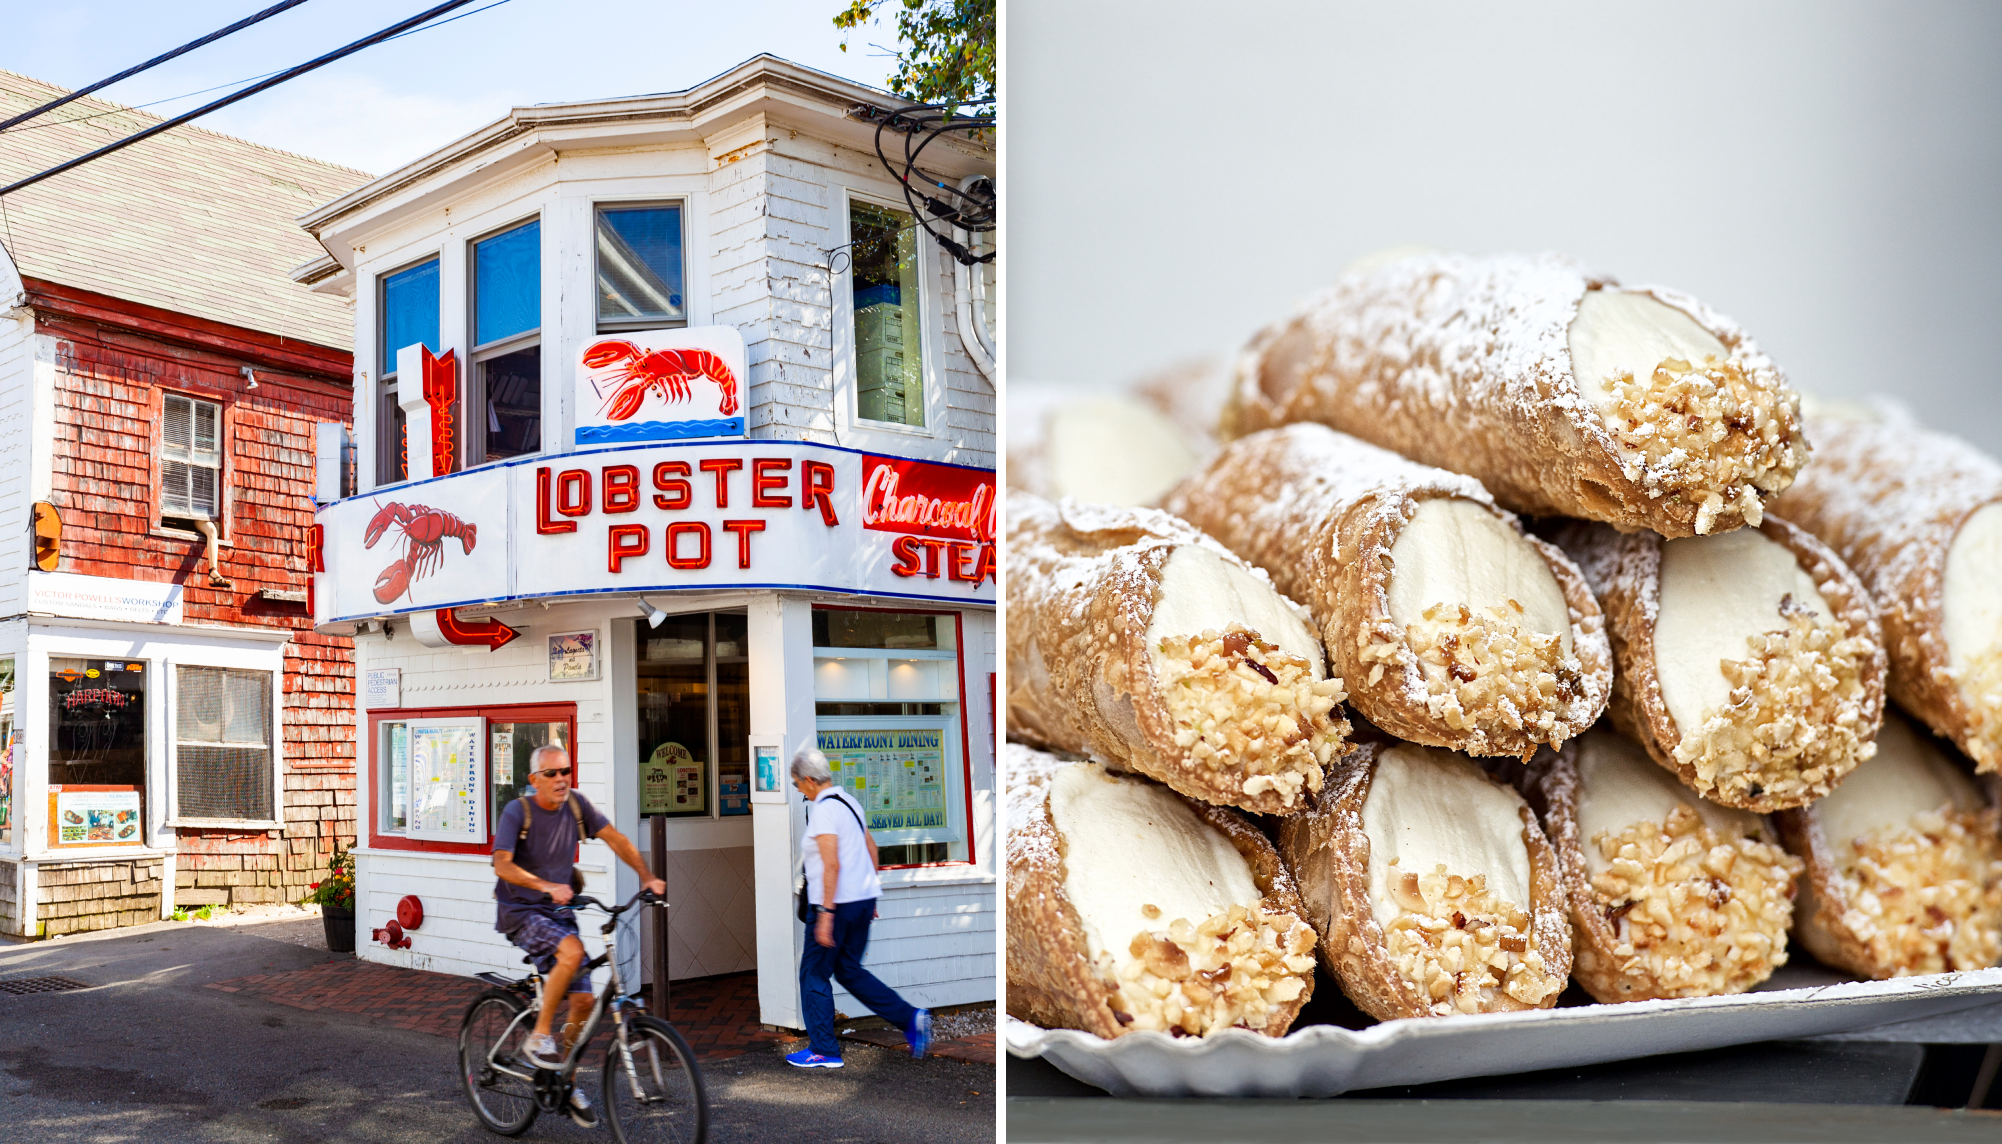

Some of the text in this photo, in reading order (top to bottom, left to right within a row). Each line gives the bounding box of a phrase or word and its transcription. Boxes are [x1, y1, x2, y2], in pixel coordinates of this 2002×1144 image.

[536, 458, 840, 535] LOBSTER
[863, 464, 993, 543] Charcoal
[607, 519, 767, 574] POT
[34, 589, 72, 599] VICTOR
[65, 601, 97, 609] SANDALS
[367, 678, 397, 686] PEDESTRIAN
[367, 686, 387, 694] ACCESS
[67, 688, 125, 709] HARPOON
[816, 730, 939, 749] WATERFRONT DINING
[656, 744, 687, 760] WELCOME
[906, 812, 922, 827] ALL
[923, 811, 943, 827] DAY!
